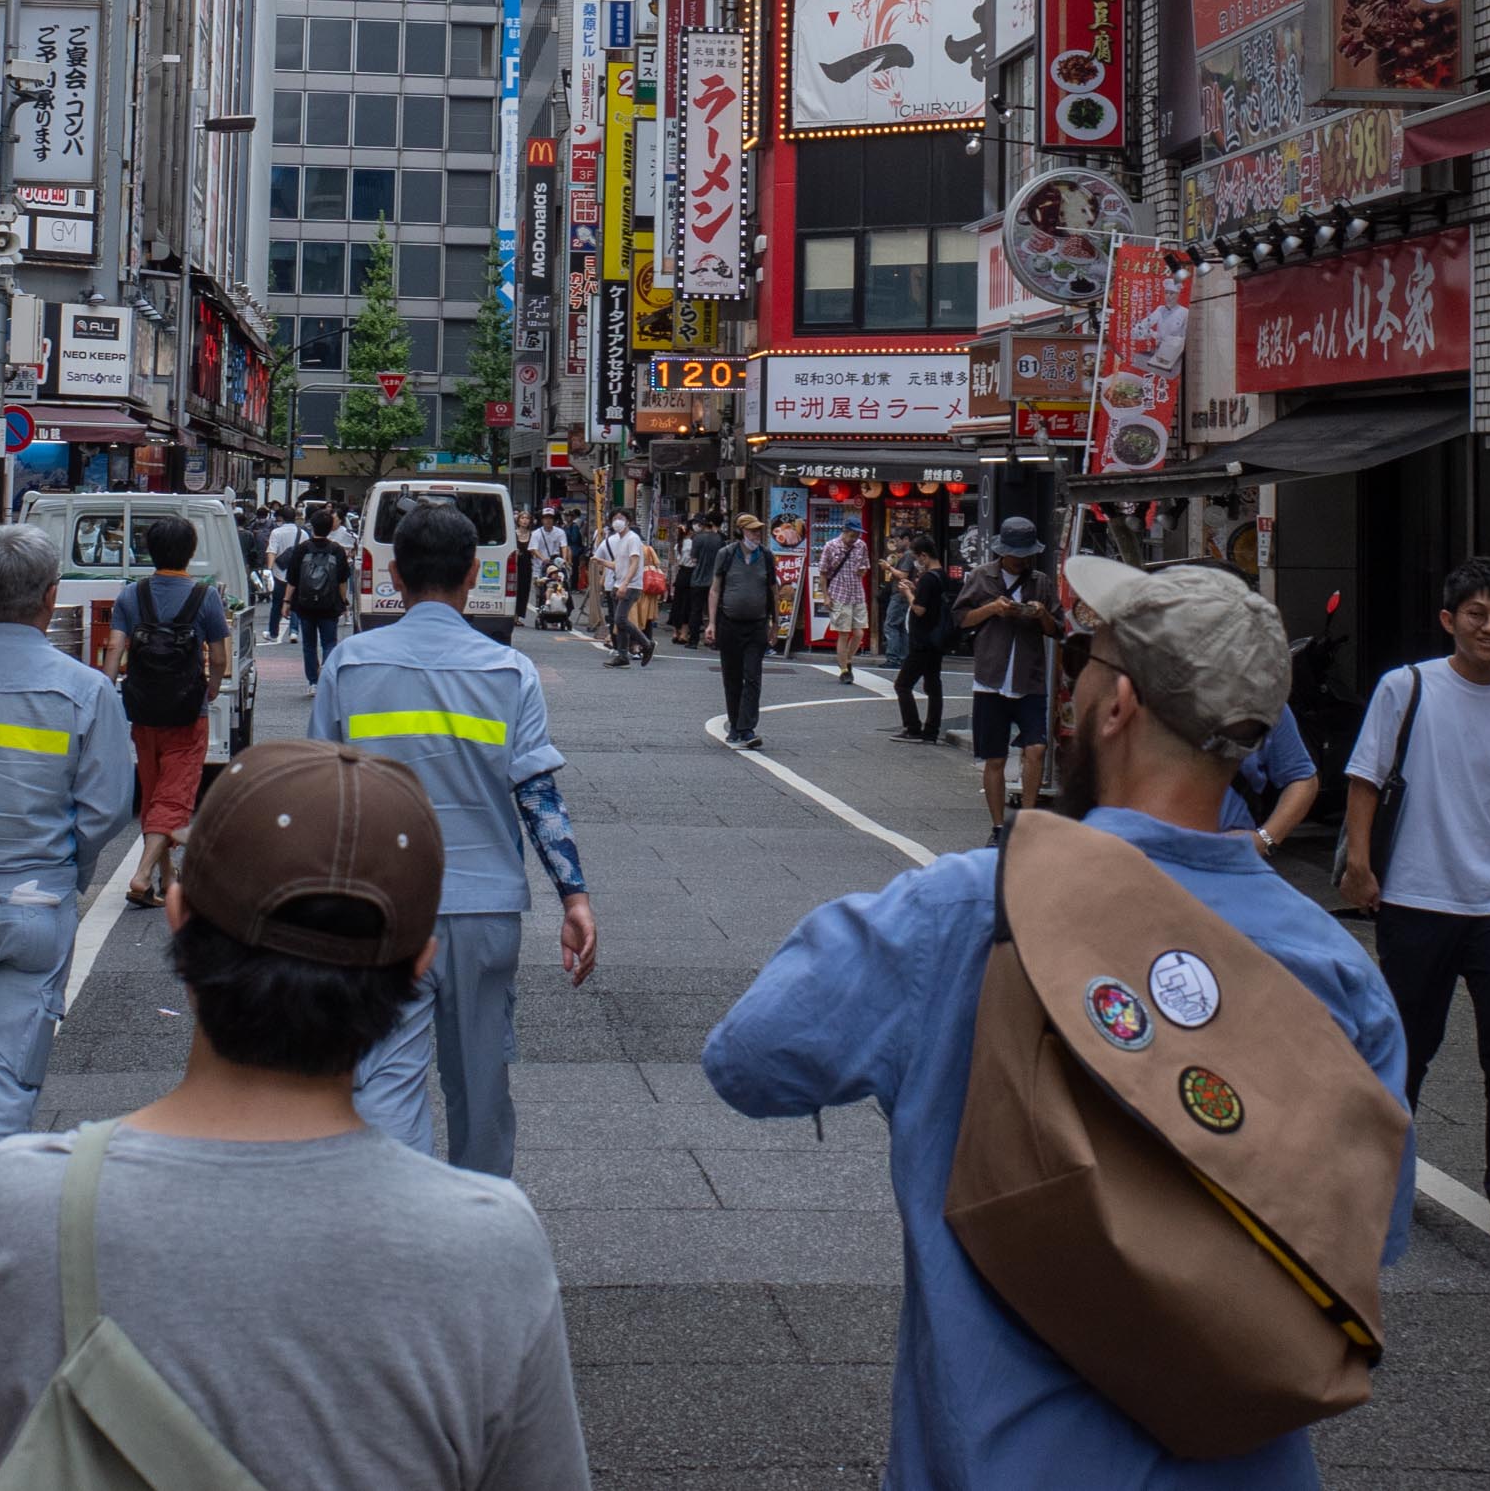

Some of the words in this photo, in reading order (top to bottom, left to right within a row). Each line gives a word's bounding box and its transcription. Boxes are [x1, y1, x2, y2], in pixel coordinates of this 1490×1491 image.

[582, 3, 597, 58] 桑原ビル
[693, 47, 738, 57] 元祖博多
[62, 24, 90, 156] ご宴会・コンパ
[894, 100, 968, 120] ICHIRYU
[691, 74, 740, 246] ラーメン
[578, 170, 594, 180] 3F
[530, 181, 548, 279] McDonald's
[569, 272, 583, 309] カメラ
[1345, 246, 1436, 360] 山本家
[63, 351, 87, 360] NEO
[89, 351, 127, 362] KEEPR
[605, 285, 627, 420] ケータイアクセサリー館
[1019, 360, 1038, 374] B1
[794, 370, 891, 389] 昭和30年創業
[908, 368, 969, 387] 元祖博多
[469, 600, 503, 610] C125-11
